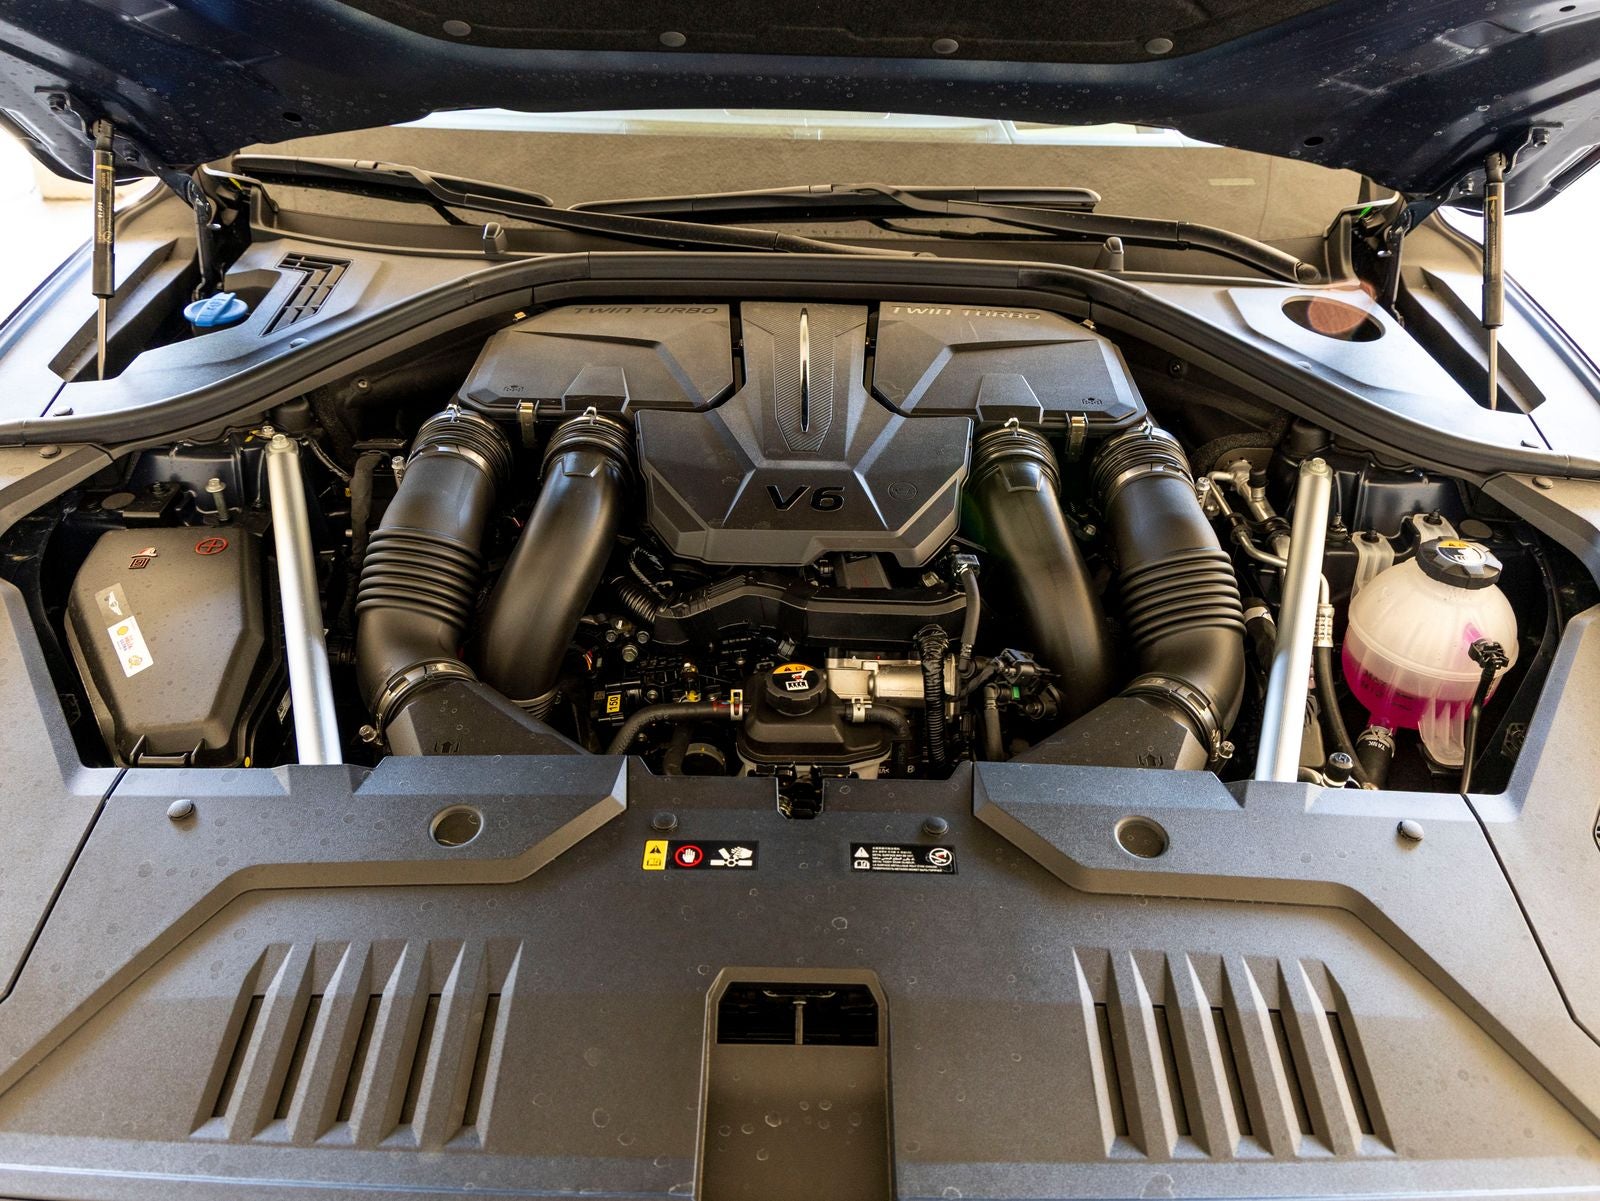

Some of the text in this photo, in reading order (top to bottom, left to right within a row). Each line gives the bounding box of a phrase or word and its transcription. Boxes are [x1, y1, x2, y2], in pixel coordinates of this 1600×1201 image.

[641, 307, 719, 315] TURBO
[891, 305, 1041, 320] TWIN TURBO
[765, 485, 846, 512] V6
[608, 696, 619, 711] 150
[1368, 740, 1385, 751] TANK
